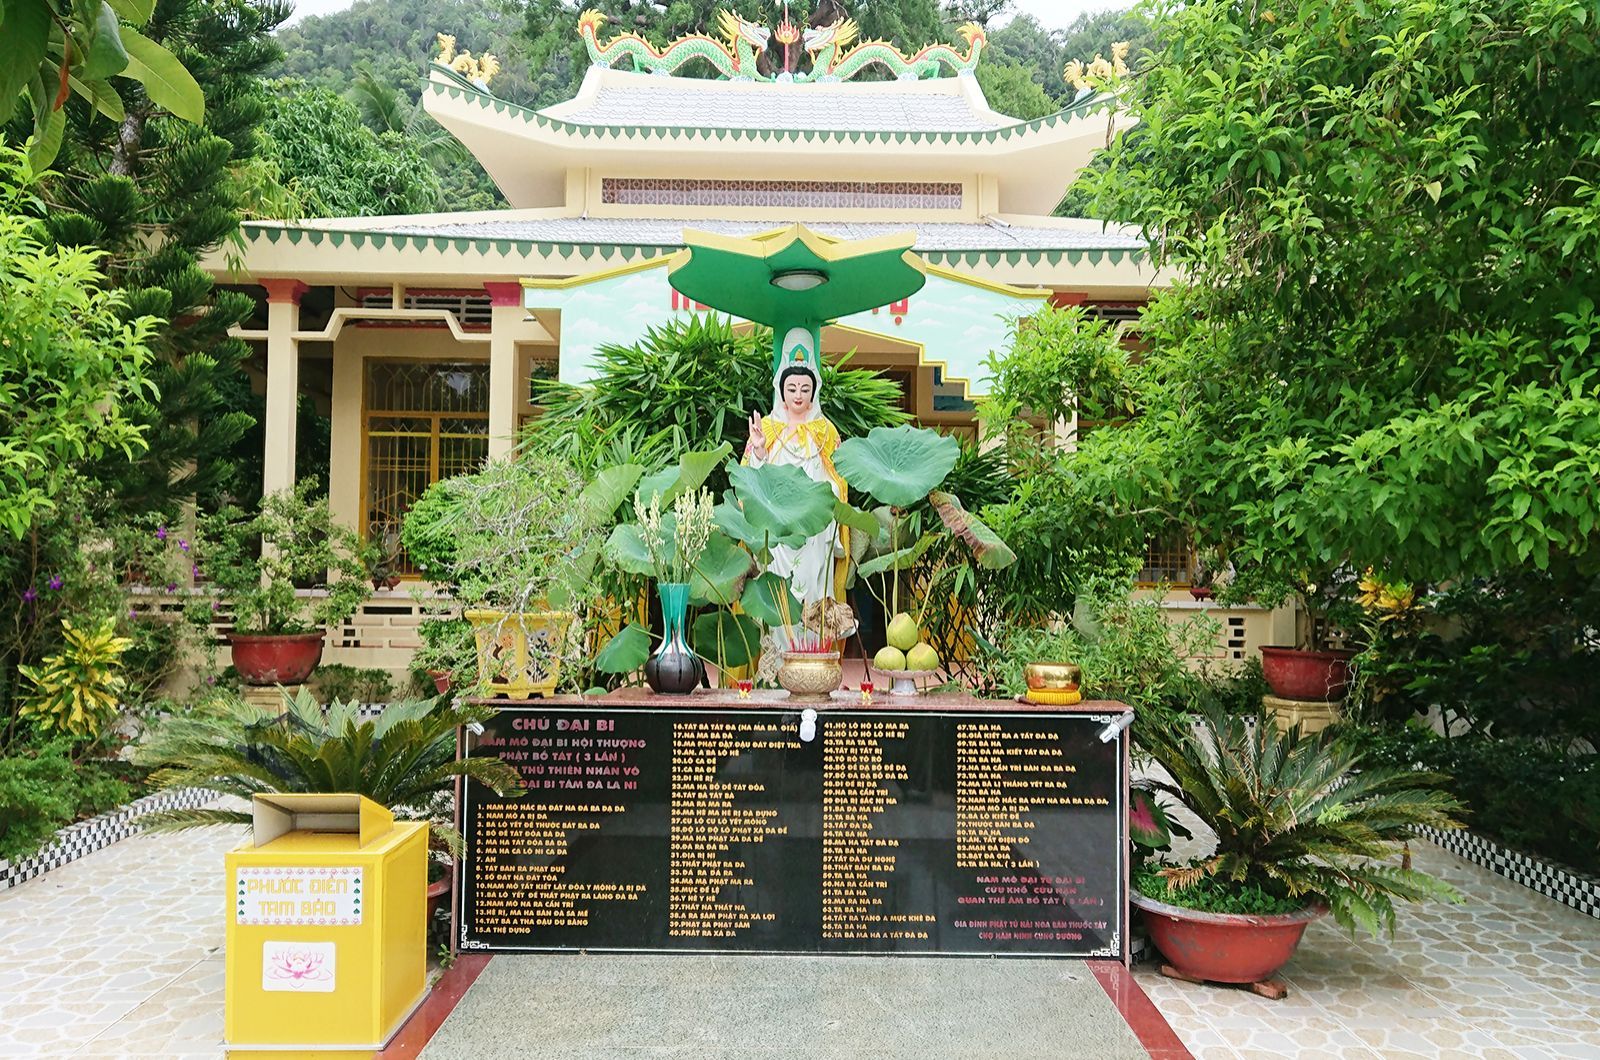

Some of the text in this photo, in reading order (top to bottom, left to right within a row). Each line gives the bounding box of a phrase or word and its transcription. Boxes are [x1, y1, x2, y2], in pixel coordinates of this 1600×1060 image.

[512, 716, 615, 732] CHÚ ĐẠI BI
[509, 737, 528, 746] MÔ
[532, 738, 552, 748] ĐẠI
[557, 738, 567, 747] BI
[572, 737, 593, 749] HỘI
[597, 738, 646, 749] THƯỢNG
[584, 753, 590, 761] 3
[544, 780, 555, 788] BI
[607, 781, 620, 789] LA
[624, 781, 637, 790] NI
